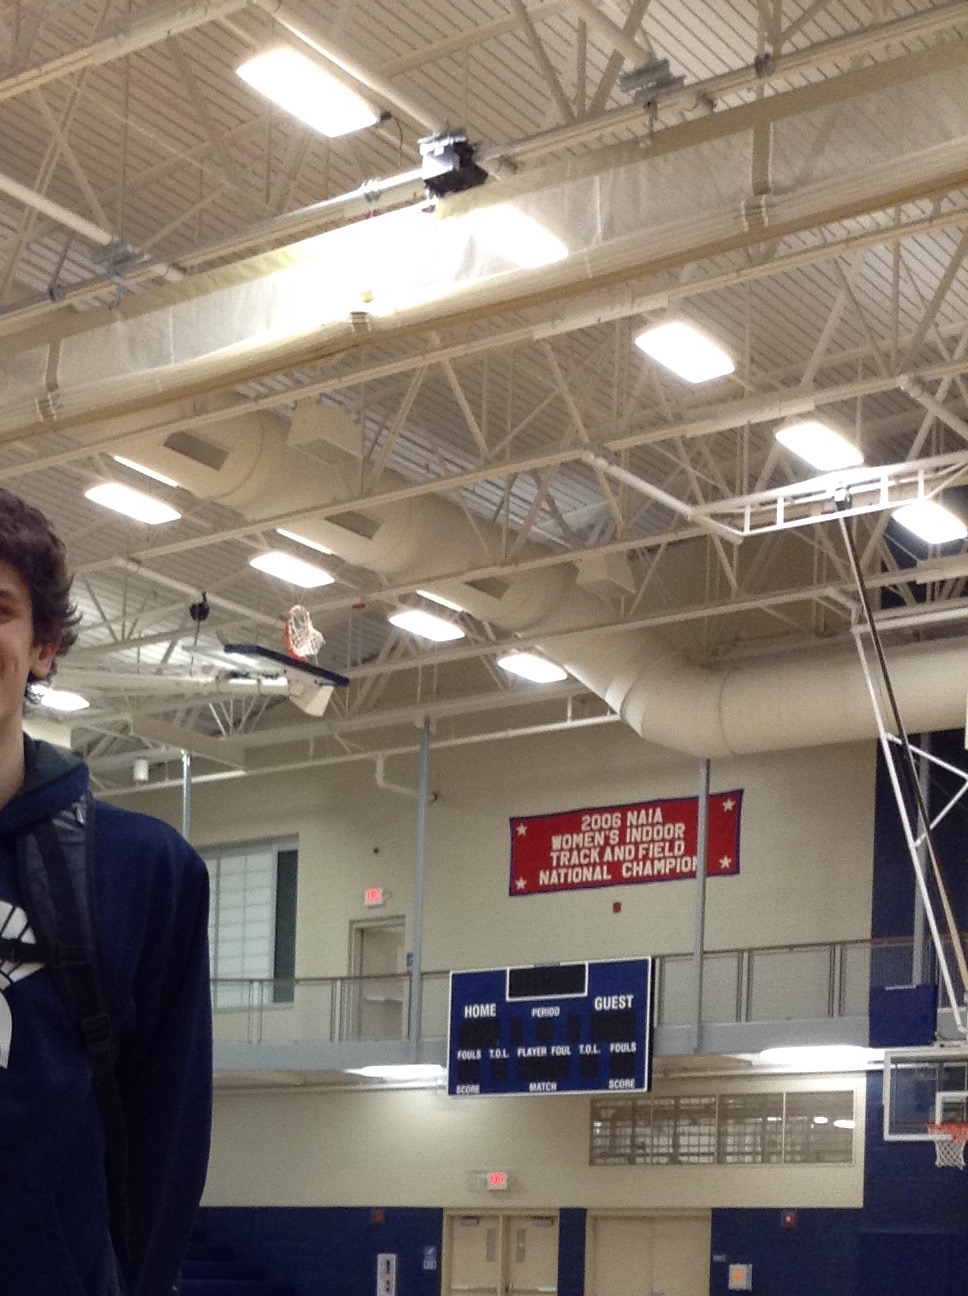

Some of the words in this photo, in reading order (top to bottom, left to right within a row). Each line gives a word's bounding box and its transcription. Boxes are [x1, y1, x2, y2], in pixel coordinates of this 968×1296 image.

[581, 812, 622, 831] 2006
[626, 807, 664, 826] NAIA
[550, 829, 620, 852] WOMEN'S
[626, 822, 686, 844] INDOOR
[550, 848, 600, 868] TRACK
[603, 844, 636, 863] AND
[638, 839, 686, 859] FIELD
[538, 864, 612, 887] NATIONAL
[594, 994, 634, 1012] GUEST
[464, 1003, 497, 1018] HOME
[531, 1005, 560, 1018] PERIOD
[517, 1046, 547, 1058] PLAYER
[551, 1045, 572, 1057] FOUL
[609, 1041, 637, 1053] FOULS
[457, 1049, 482, 1061] FOULS
[456, 1084, 481, 1095] SCORE
[529, 1081, 558, 1092] MATCH
[608, 1078, 636, 1090] SCORE
